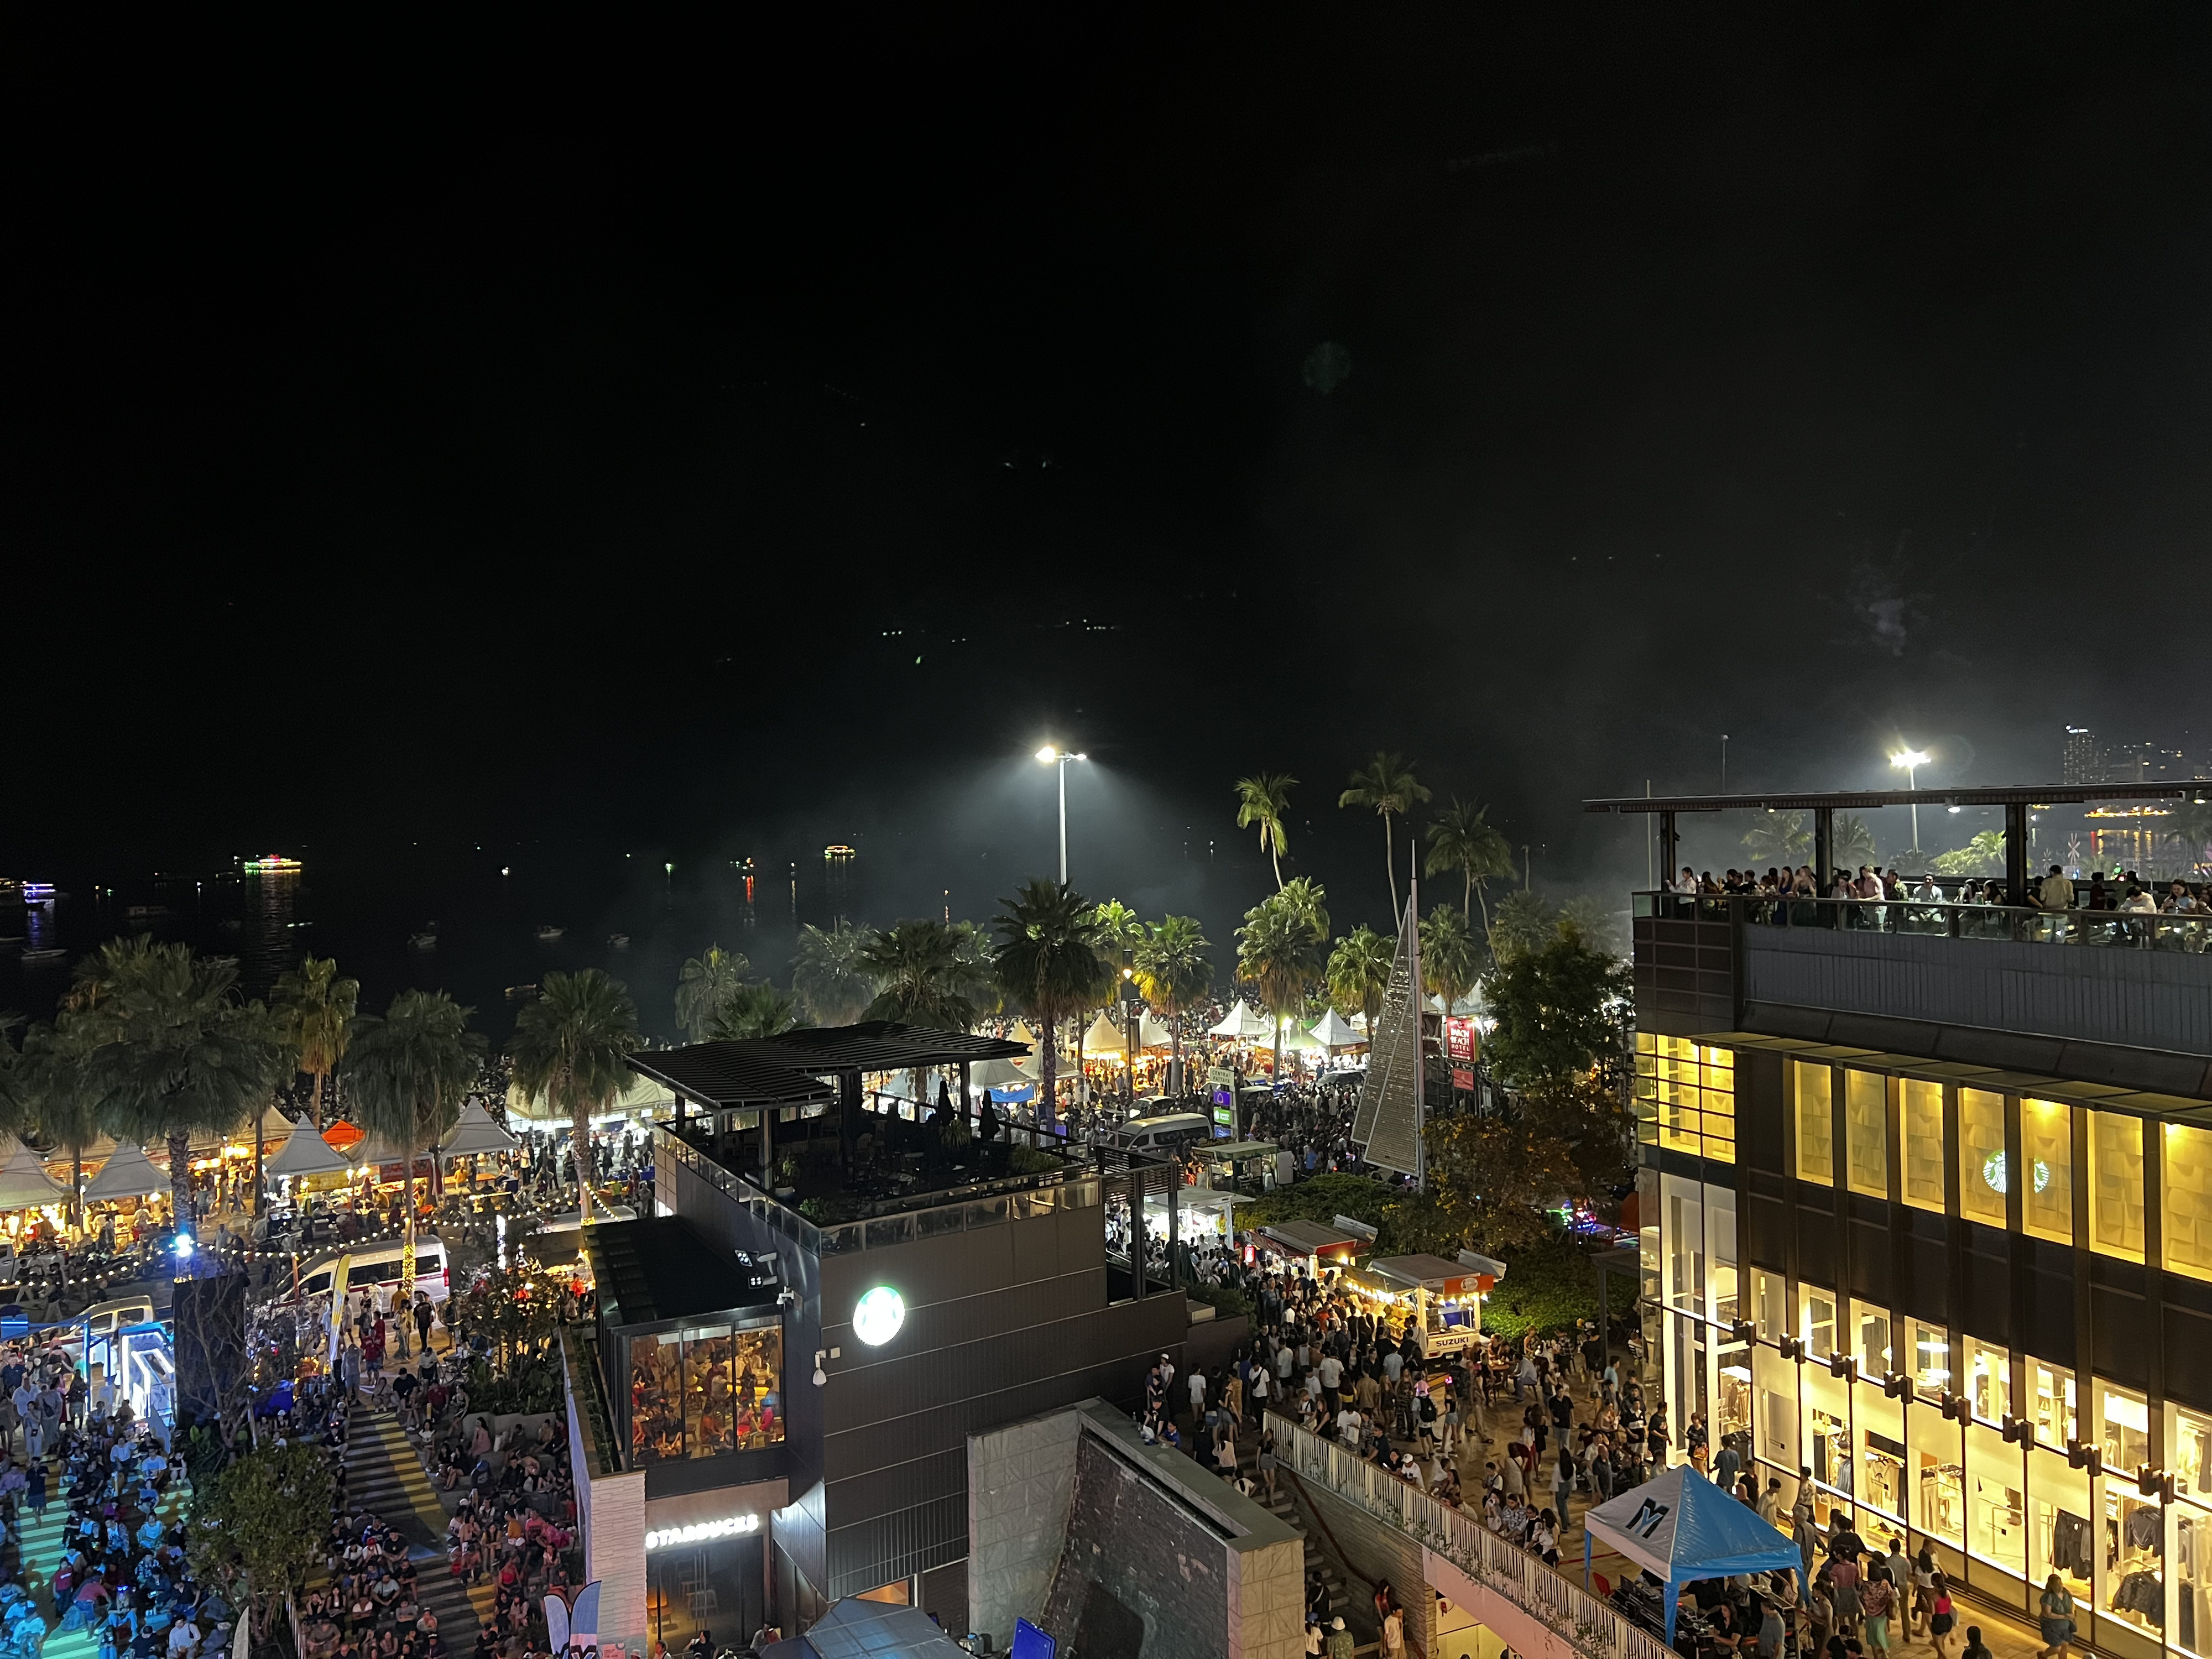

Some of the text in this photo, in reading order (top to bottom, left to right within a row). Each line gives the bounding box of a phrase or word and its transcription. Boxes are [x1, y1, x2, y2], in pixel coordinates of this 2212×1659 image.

[1213, 1076, 1230, 1084] PATTAYA
[1436, 1337, 1469, 1347] SUZUKI
[645, 1514, 759, 1548] STARBUCKS
